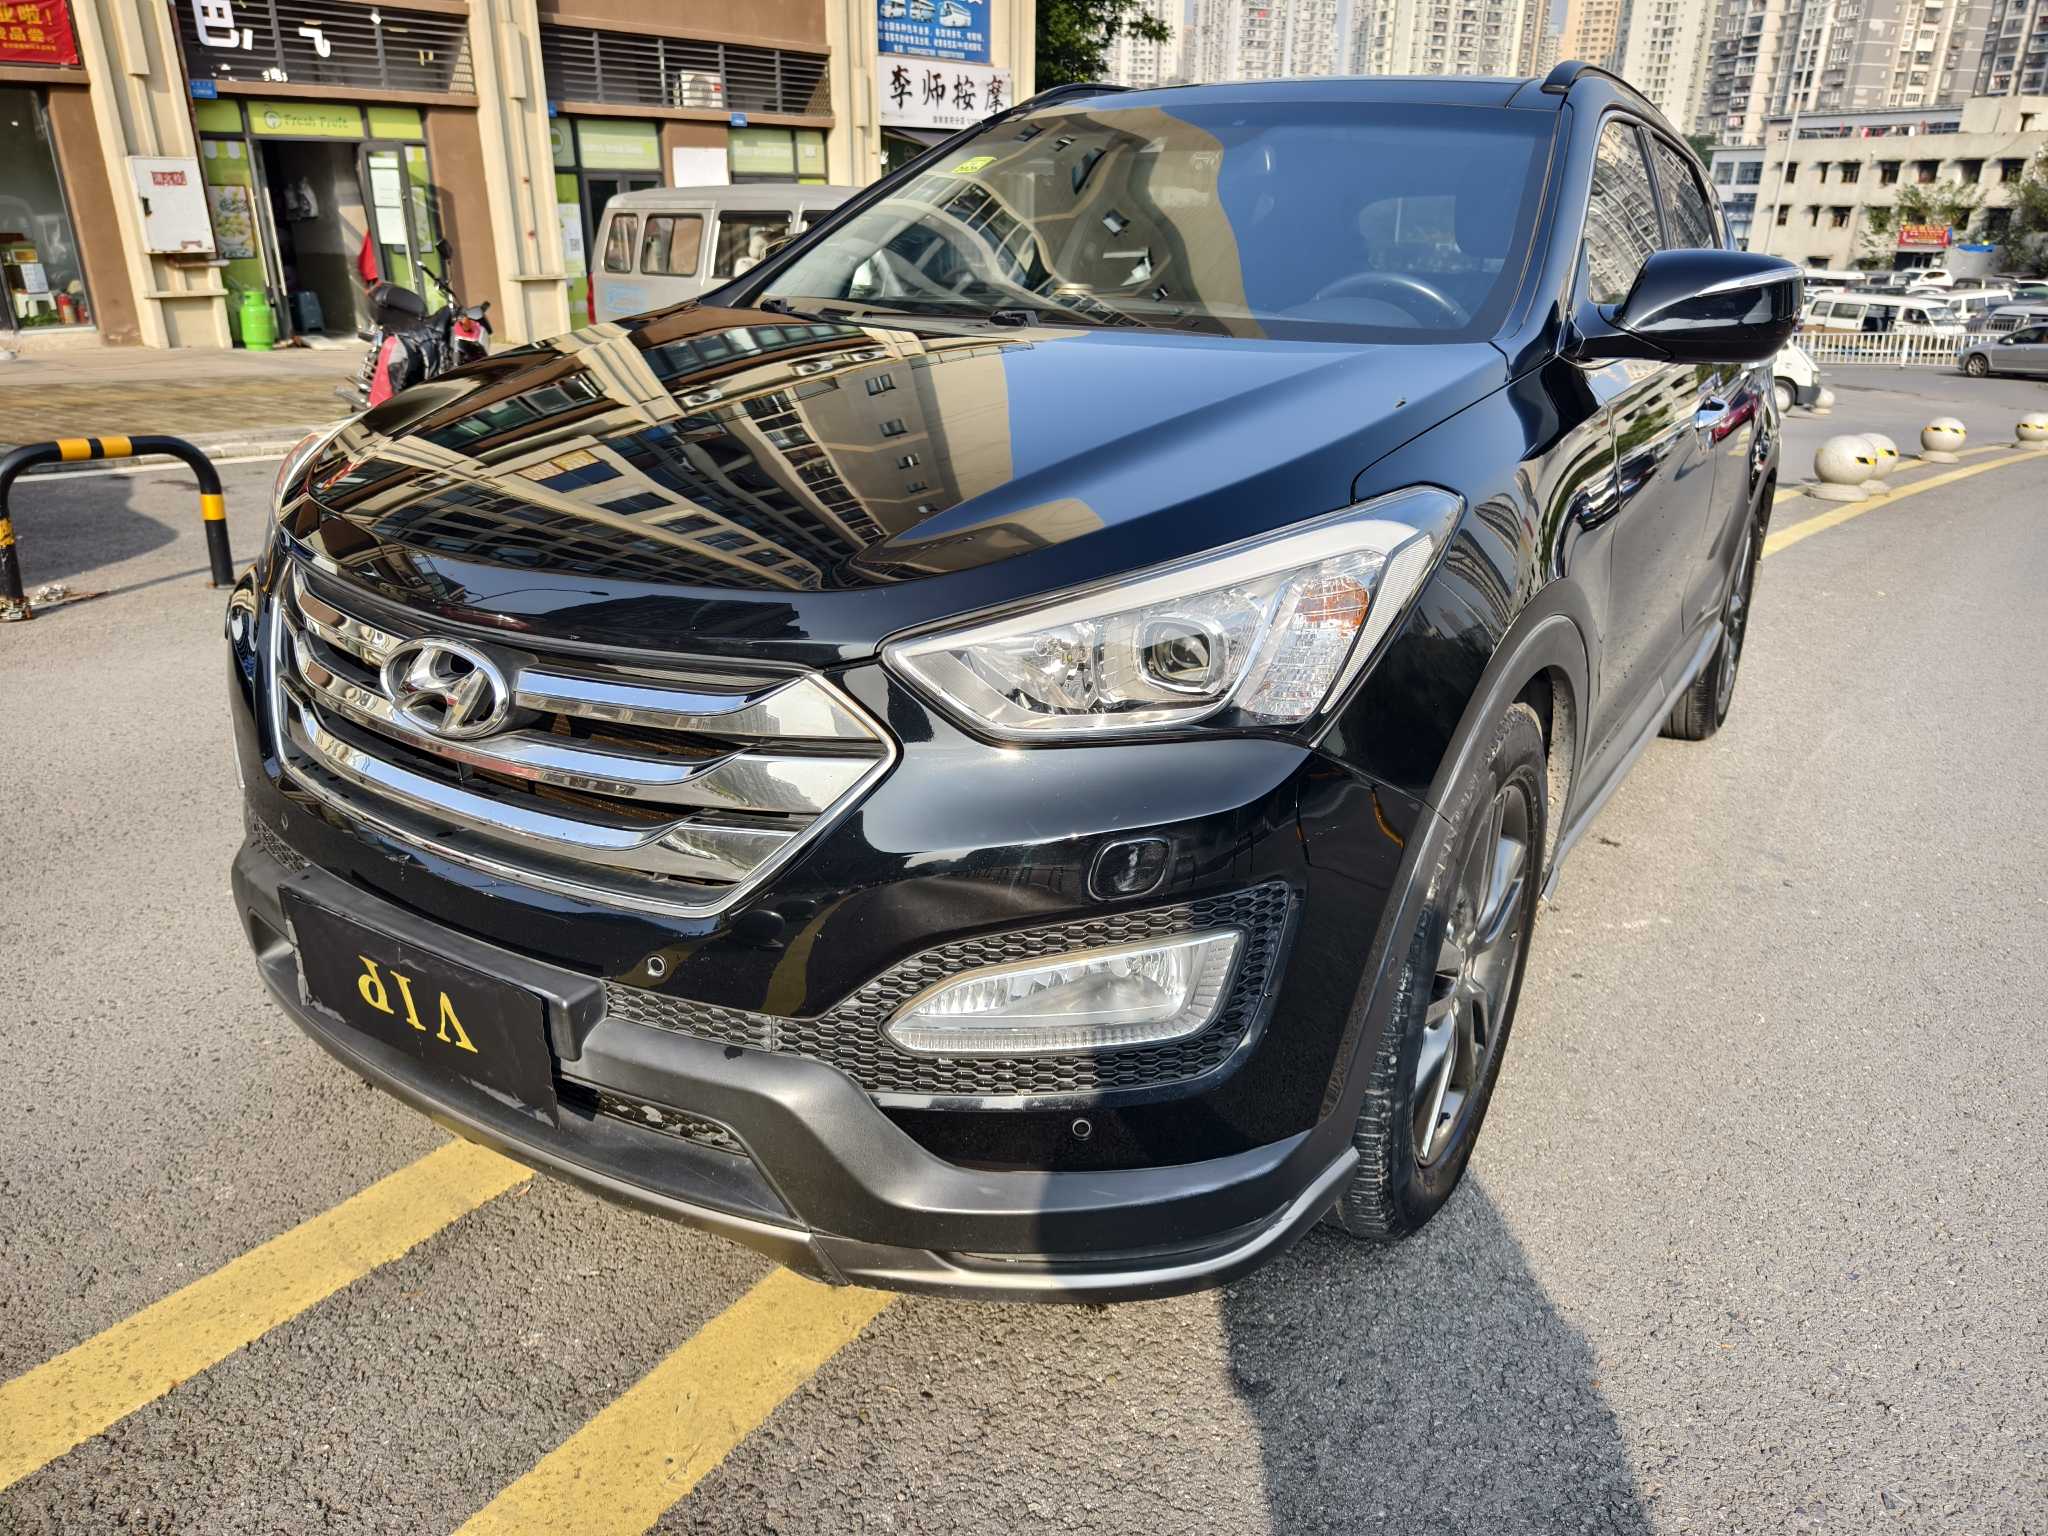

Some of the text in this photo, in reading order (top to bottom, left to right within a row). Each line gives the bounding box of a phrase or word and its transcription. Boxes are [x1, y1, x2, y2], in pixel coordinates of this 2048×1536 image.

[889, 64, 1004, 115] 李师按摩
[357, 954, 478, 1053] VIP
